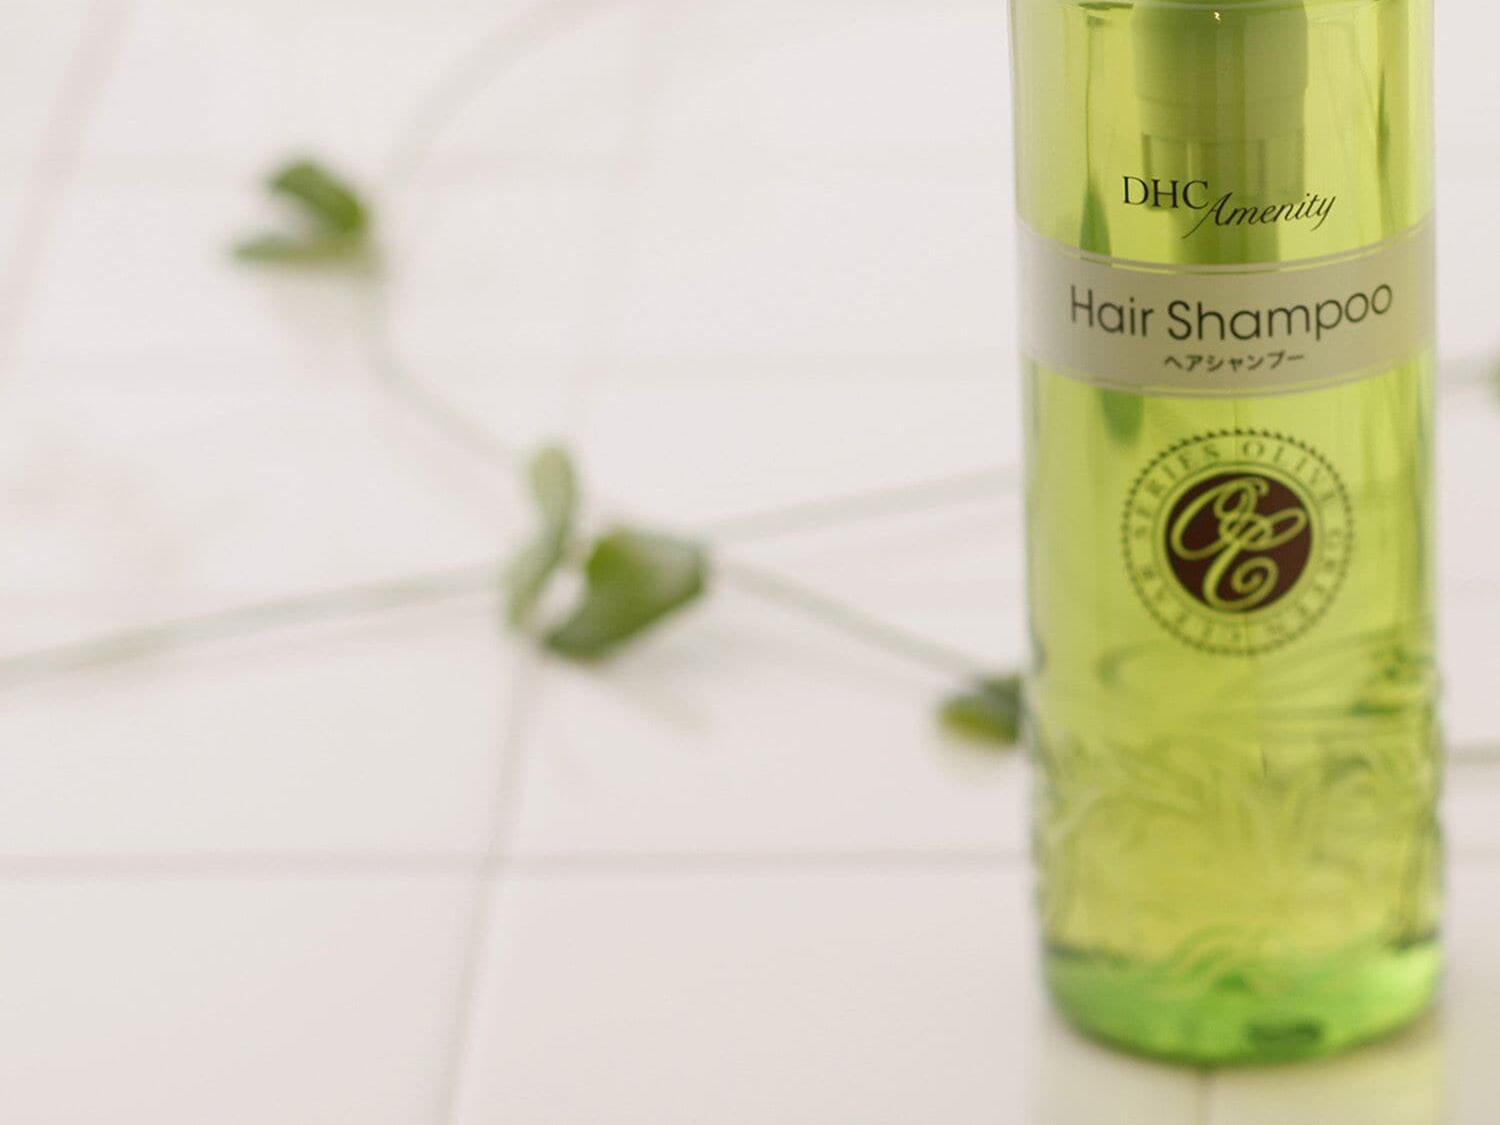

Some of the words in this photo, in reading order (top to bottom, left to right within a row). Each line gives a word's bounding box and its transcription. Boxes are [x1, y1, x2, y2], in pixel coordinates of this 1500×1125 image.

[1122, 175, 1209, 211] DHC
[1181, 191, 1337, 239] Amenity
[1070, 284, 1154, 338] Hair
[1167, 282, 1394, 342] Shampoo
[1164, 350, 1306, 373] ヘアシャンプー
